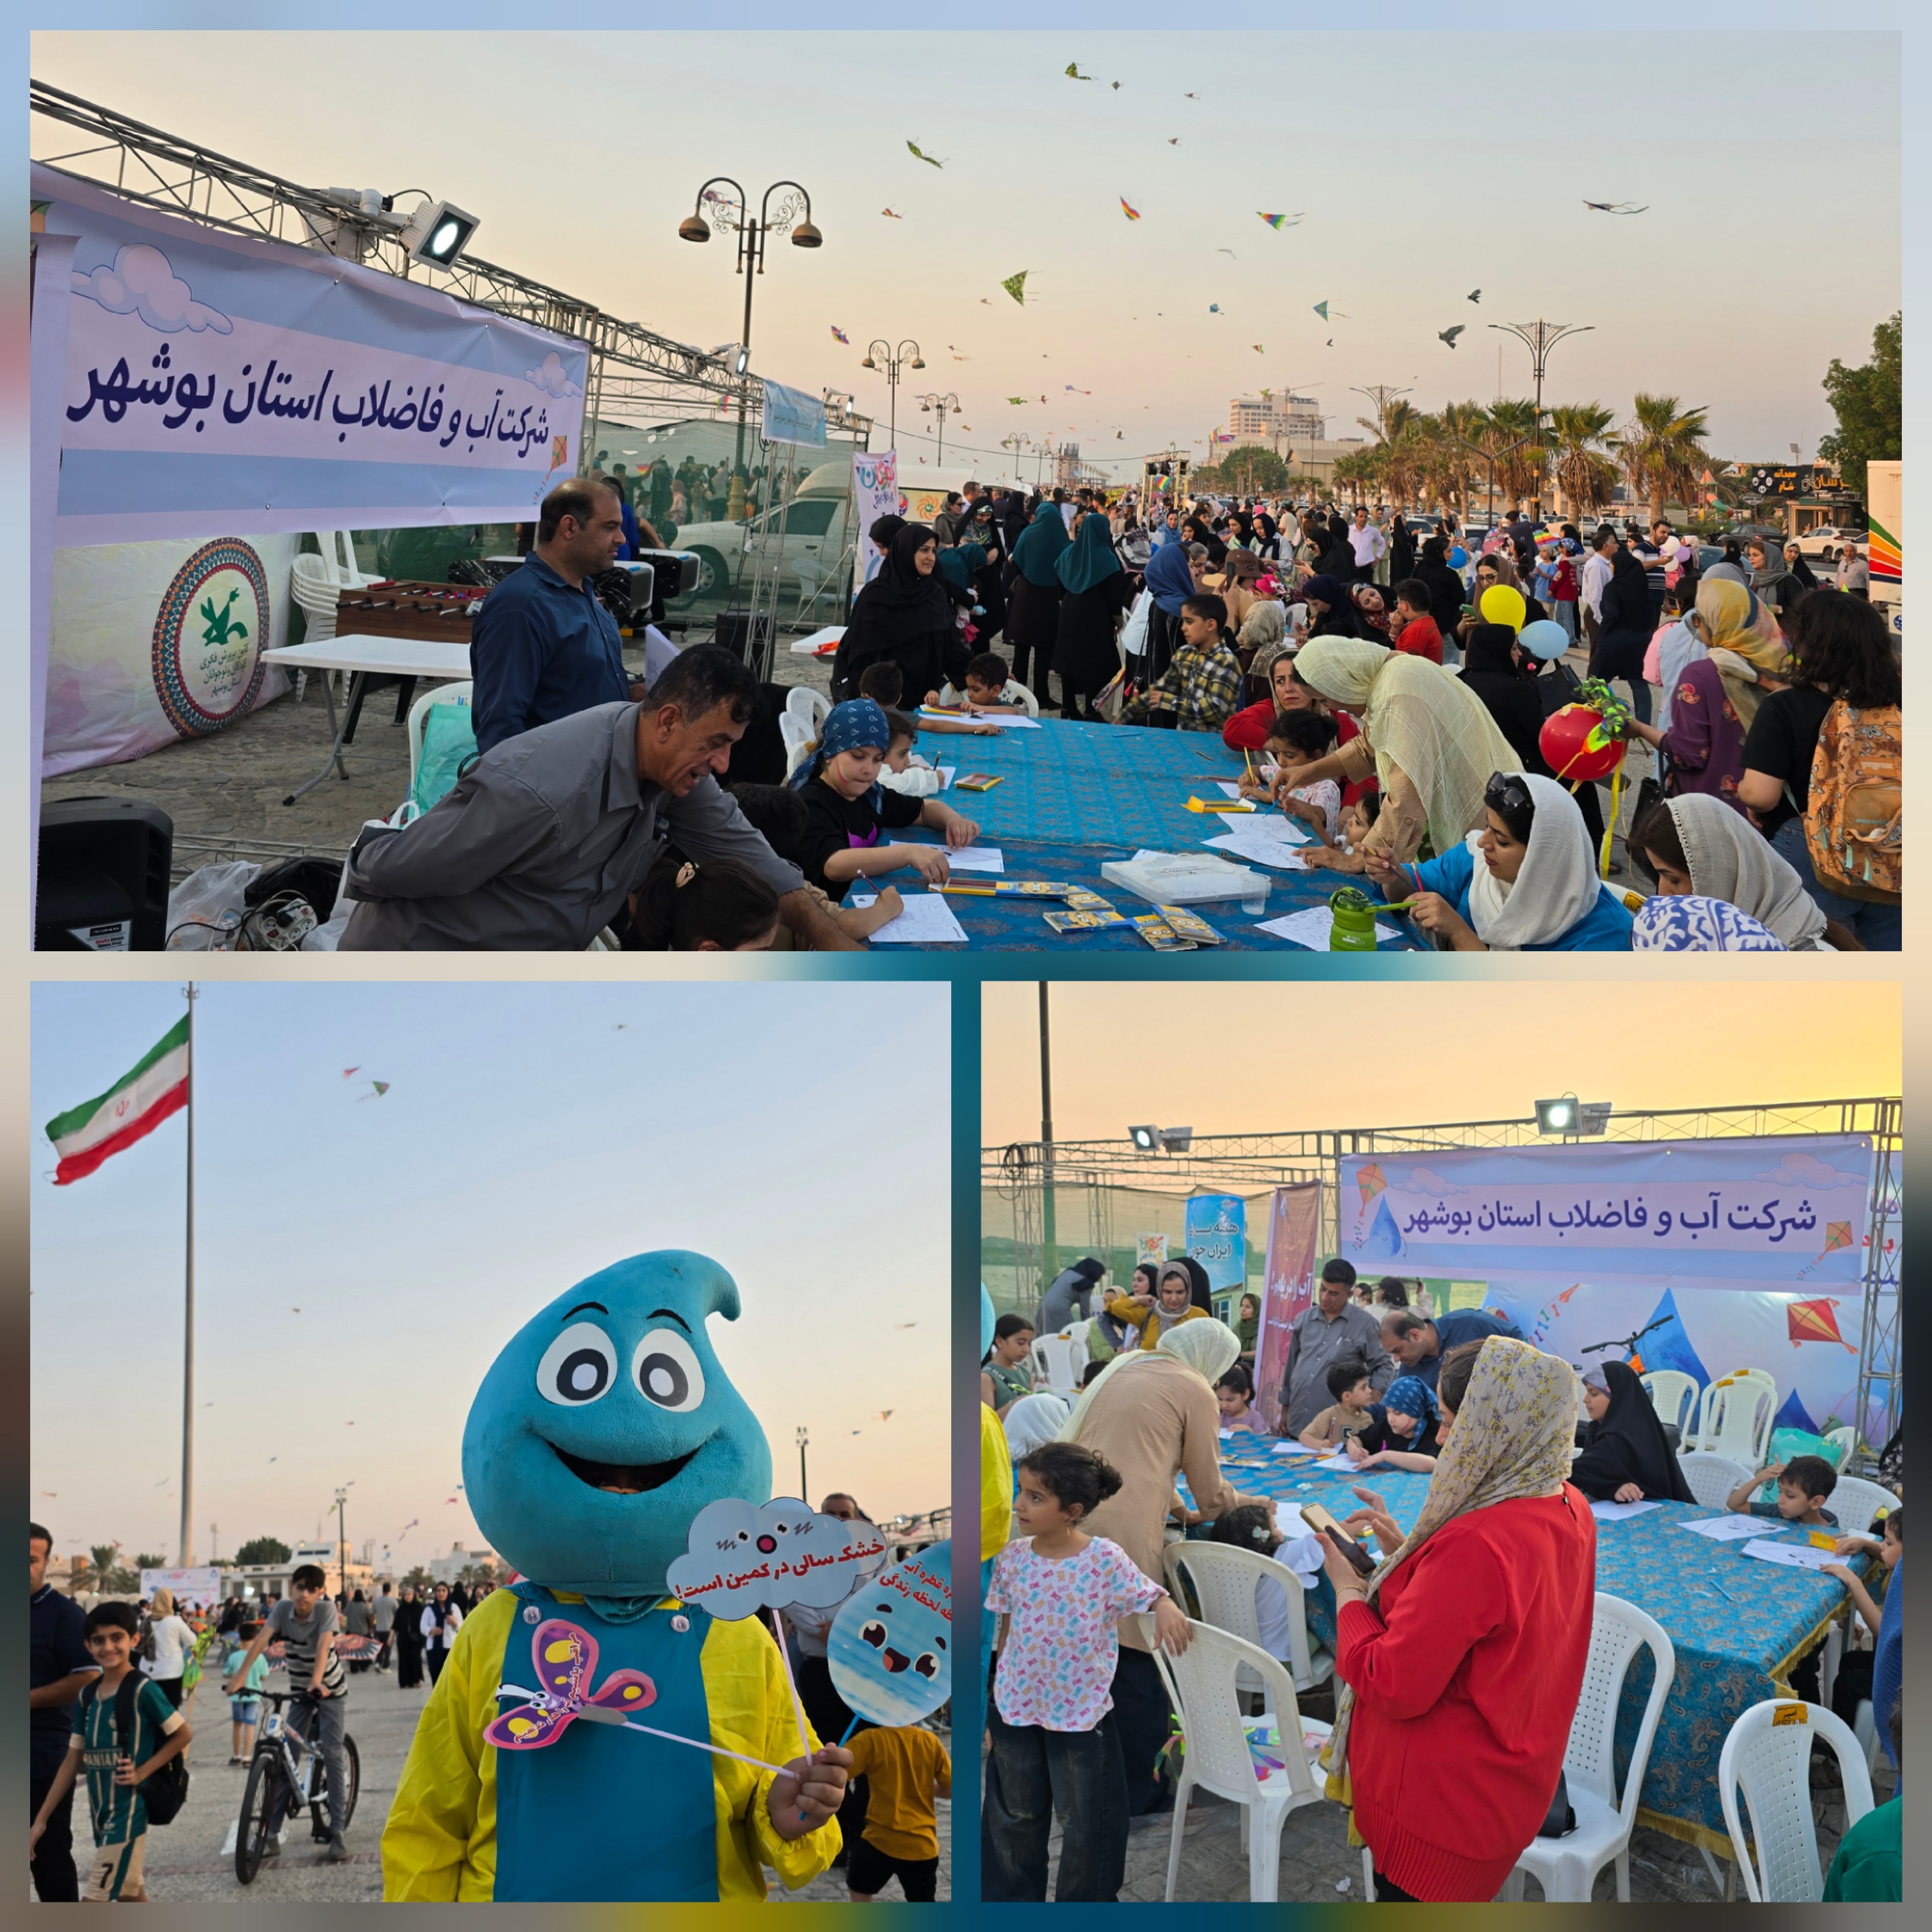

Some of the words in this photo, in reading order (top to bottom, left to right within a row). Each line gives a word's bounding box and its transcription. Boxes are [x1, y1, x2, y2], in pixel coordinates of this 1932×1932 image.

[66, 343, 216, 433] بوشهر
[223, 360, 334, 424] استان
[332, 380, 445, 443] فاضلاب
[466, 388, 503, 453] آب
[439, 409, 462, 448] و
[495, 405, 549, 458] شرکت
[1403, 1201, 1472, 1236] بوشهر
[1478, 1199, 1541, 1232] استان
[1548, 1196, 1648, 1237] فاضلاب
[1654, 1211, 1672, 1237] و
[1680, 1191, 1721, 1240] آب
[1727, 1199, 1817, 1242] شرکت
[1208, 1243, 1231, 1259] ایران
[1298, 1272, 1313, 1301] آب
[838, 1538, 885, 1562] خشک
[725, 1562, 771, 1590] کمین
[773, 1560, 790, 1581] در
[792, 1553, 835, 1577] سالی
[903, 1560, 924, 1575] آب
[674, 1574, 724, 1601] است!
[879, 1573, 912, 1598] زندگی
[919, 1570, 945, 1590] قطره
[912, 1591, 941, 1612] لحظه
[569, 1633, 584, 1665] مراقب
[568, 1666, 583, 1701] باشیم
[513, 1721, 547, 1743] ندهیم
[546, 1712, 561, 1725] هدر
[99, 1863, 113, 1889] 7
